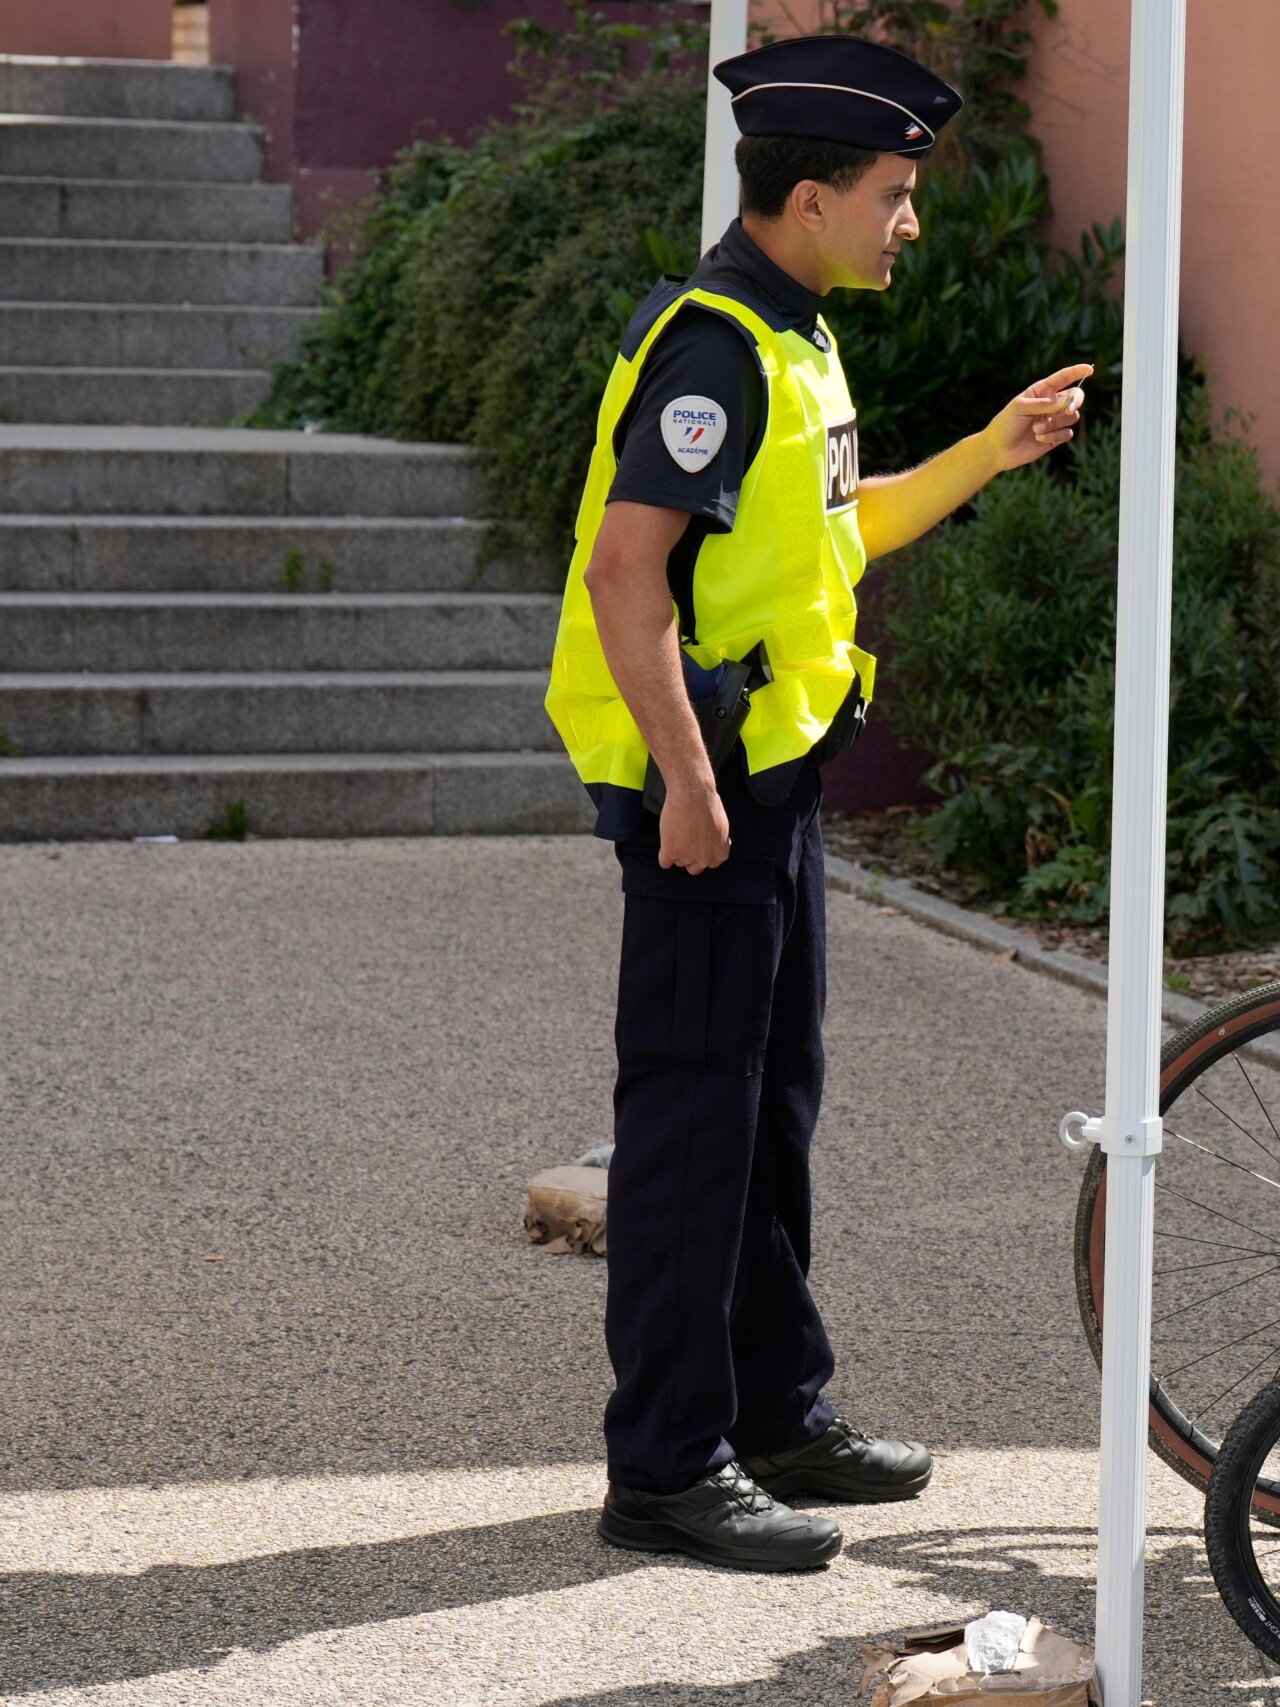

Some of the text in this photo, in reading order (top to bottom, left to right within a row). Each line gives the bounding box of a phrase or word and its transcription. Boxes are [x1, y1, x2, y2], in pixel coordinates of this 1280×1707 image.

[673, 410, 716, 420] POLICE
[673, 418, 716, 426] NATIONALE
[678, 446, 708, 455] ACADÉMIE
